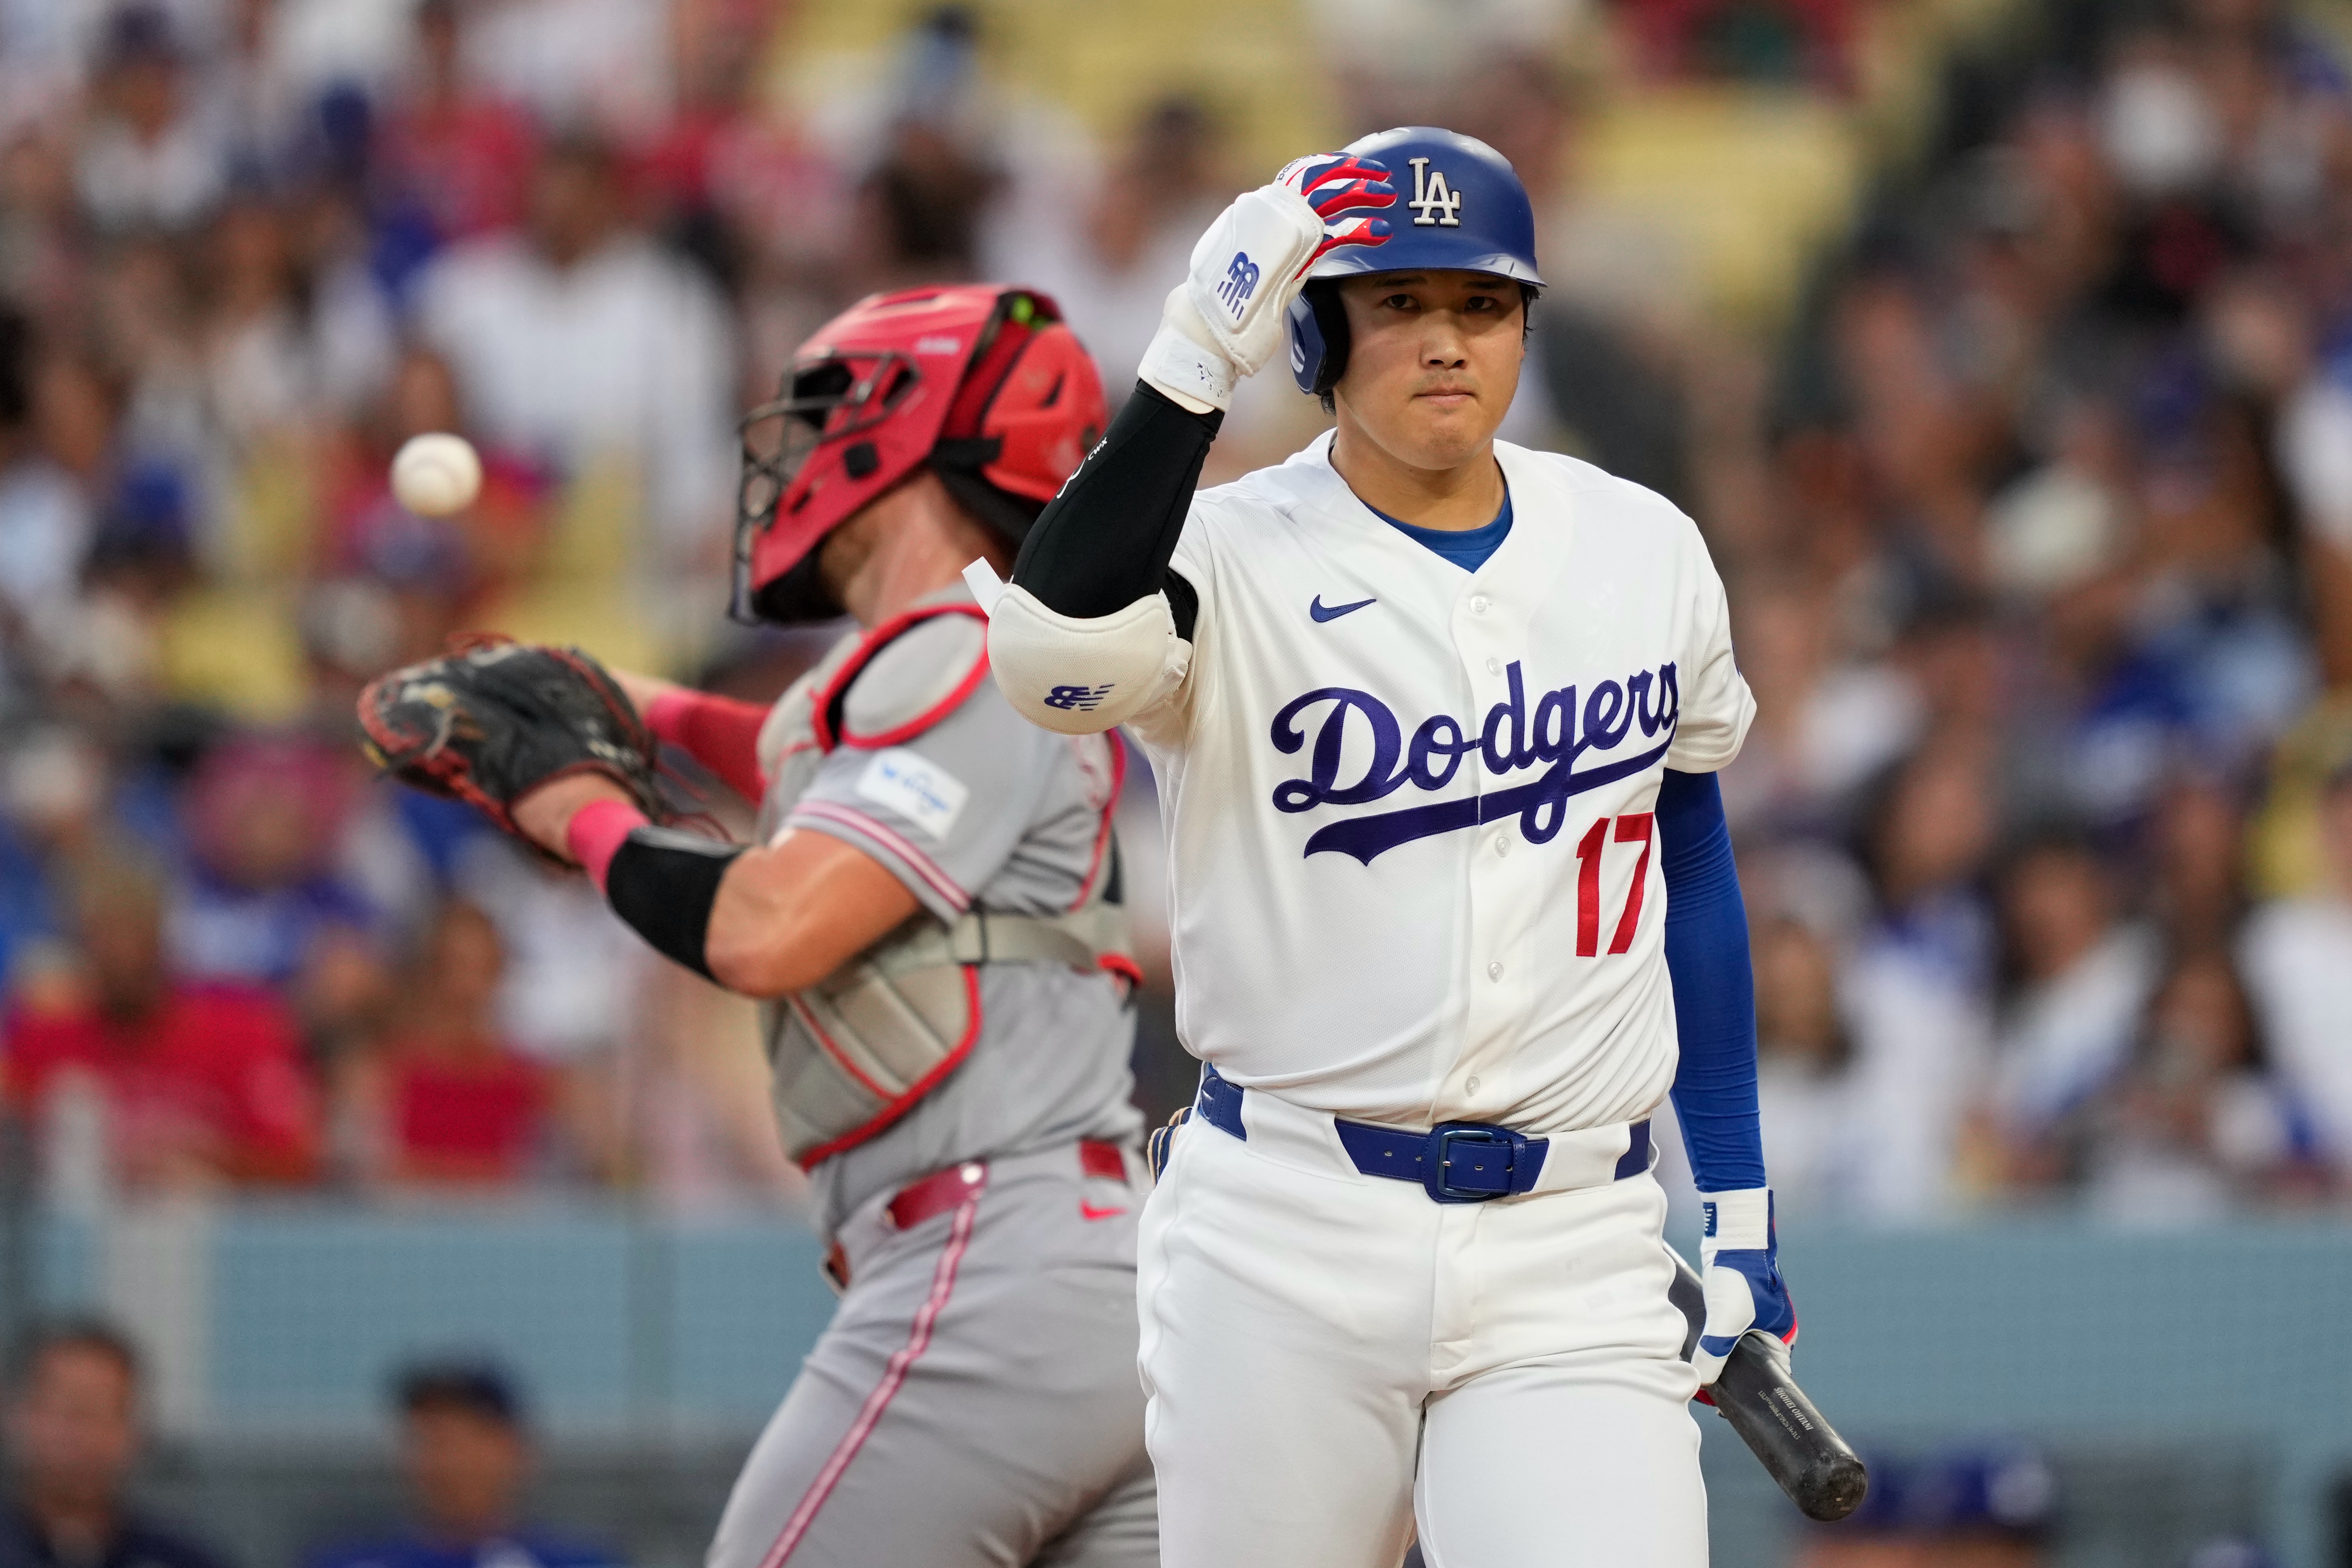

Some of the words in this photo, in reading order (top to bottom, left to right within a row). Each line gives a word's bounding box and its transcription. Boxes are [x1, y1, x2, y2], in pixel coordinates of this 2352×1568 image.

[1409, 157, 1461, 227] LA
[1271, 660, 1678, 843] Dodgers
[1576, 812, 1653, 957] 17
[1774, 1387, 1797, 1409] SHOHEI
[1791, 1409, 1814, 1431] OHTANI
